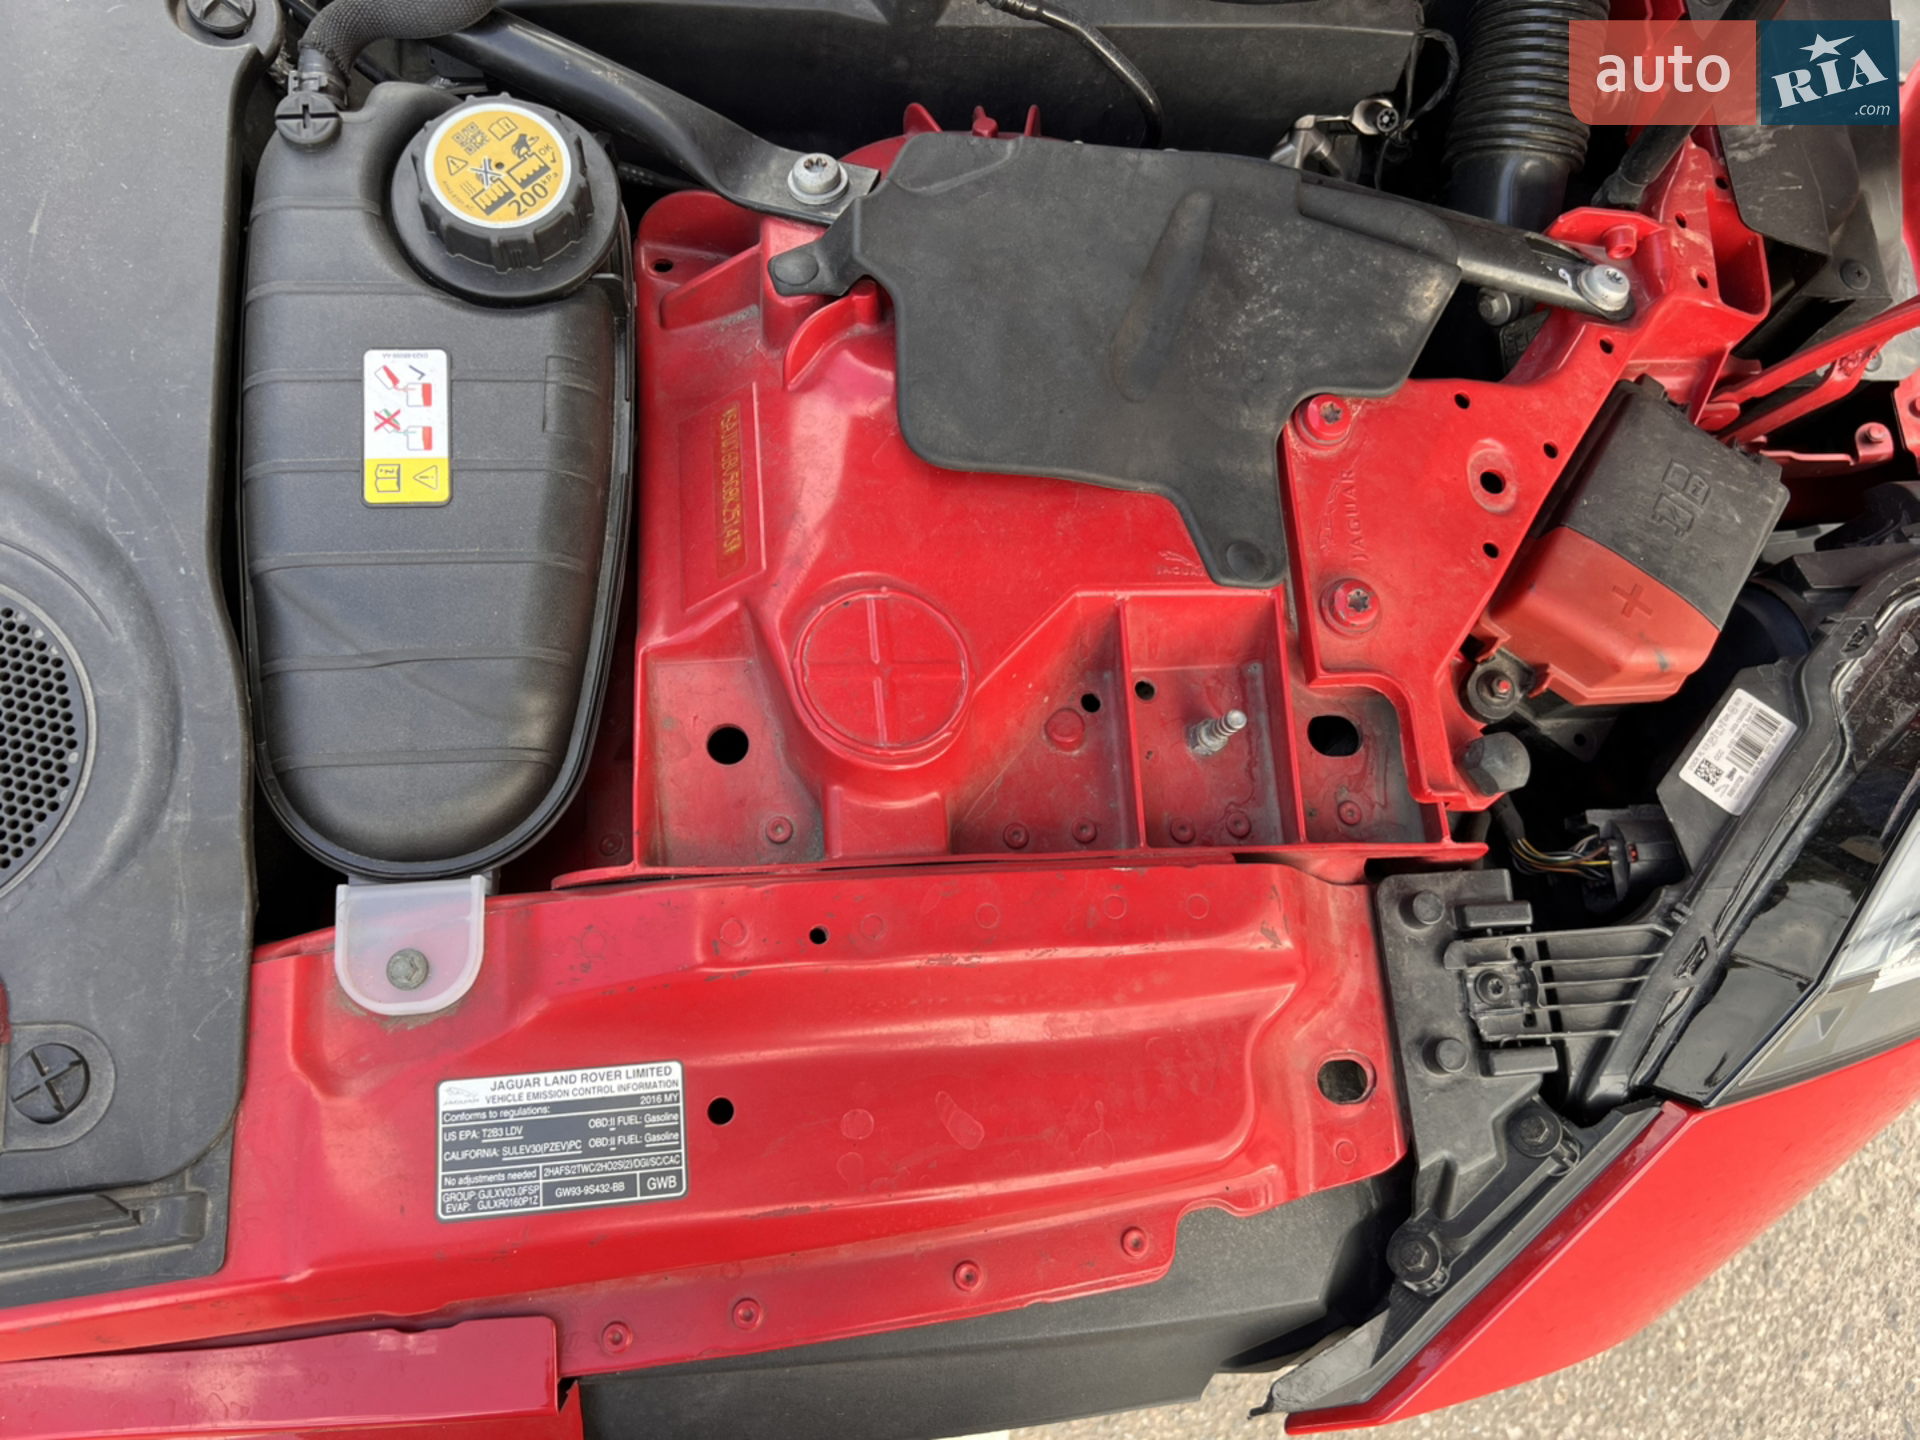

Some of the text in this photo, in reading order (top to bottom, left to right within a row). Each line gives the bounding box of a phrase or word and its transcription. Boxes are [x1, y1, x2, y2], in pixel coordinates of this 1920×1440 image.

[538, 143, 553, 157] OK
[508, 172, 558, 216] 200 kPa
[1341, 469, 1369, 561] JAGUAR
[490, 1065, 672, 1091] JAGUAR LAND ROVER LIMITED
[485, 1078, 679, 1105] VEHICLE EMISSION CONTROL INFORMATION
[640, 1092, 679, 1105] 2016 MY
[443, 1105, 550, 1123] Conforms to regulations:
[617, 1114, 643, 1126] FUEL:
[644, 1112, 679, 1124] Gasoline
[443, 1125, 524, 1142] US EPA: T2B3 LDV
[617, 1134, 643, 1145] FUEL:
[644, 1131, 680, 1143] Gasoline
[443, 1147, 500, 1162] CALIFORNIA:
[444, 1168, 537, 1186] No adjustments needed
[647, 1175, 677, 1190] GWB
[442, 1190, 478, 1203] GROUP:
[555, 1181, 626, 1198] GW93-9S432-BB
[445, 1202, 472, 1214] EVAP:
